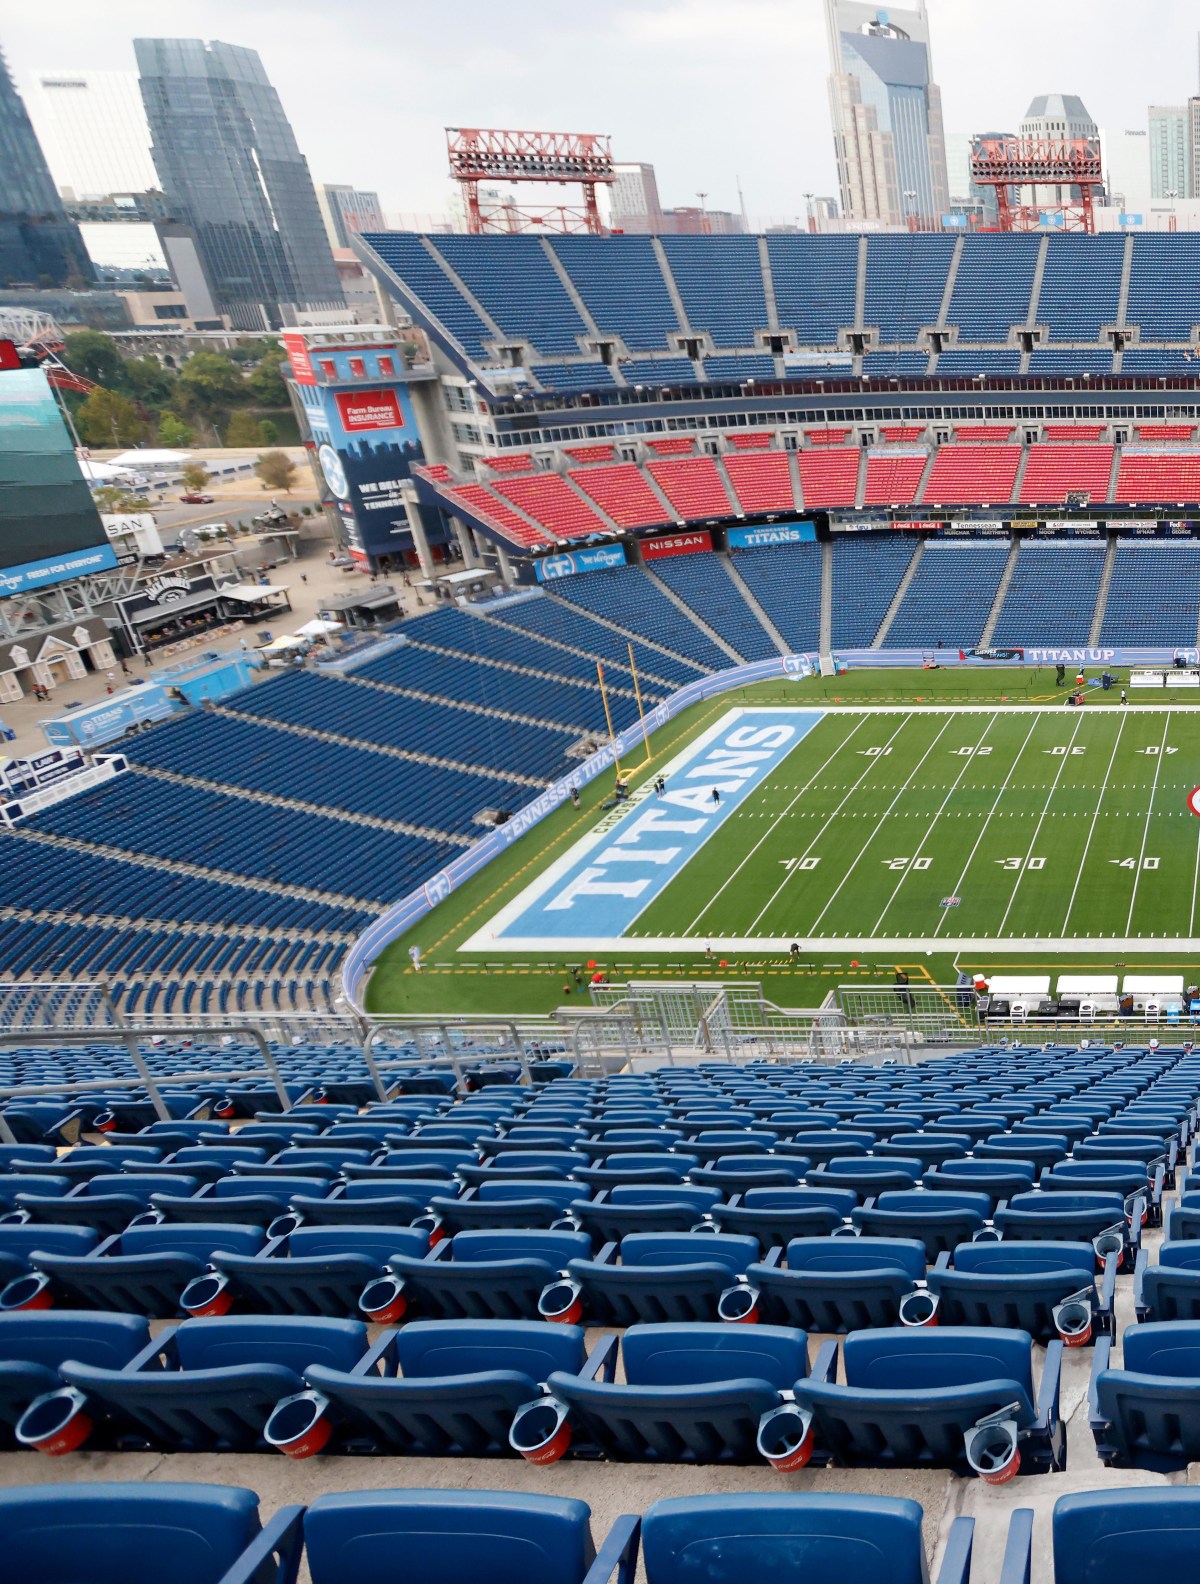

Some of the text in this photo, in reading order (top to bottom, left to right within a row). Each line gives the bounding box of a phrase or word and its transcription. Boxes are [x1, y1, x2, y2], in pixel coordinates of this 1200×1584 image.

[347, 405, 393, 415] Farm Bureau
[348, 411, 395, 422] INSURANCE
[358, 482, 378, 493] WE
[753, 526, 789, 534] TENNESSEE
[650, 535, 703, 551] NISSAN
[744, 530, 800, 545] TITANS
[592, 550, 622, 566] Kroger
[27, 567, 51, 580] FRESH
[51, 563, 67, 573] FOR
[1029, 649, 1116, 661] TITAN UP
[90, 707, 124, 725] TITANS
[864, 747, 893, 756] 10
[956, 746, 993, 755] 20
[1051, 746, 1086, 755] 30
[1143, 746, 1180, 755] 40
[543, 724, 796, 911] TITANS
[785, 857, 821, 870] 10
[888, 857, 934, 870] 20
[1003, 857, 1048, 870] 30
[1119, 857, 1161, 870] 40
